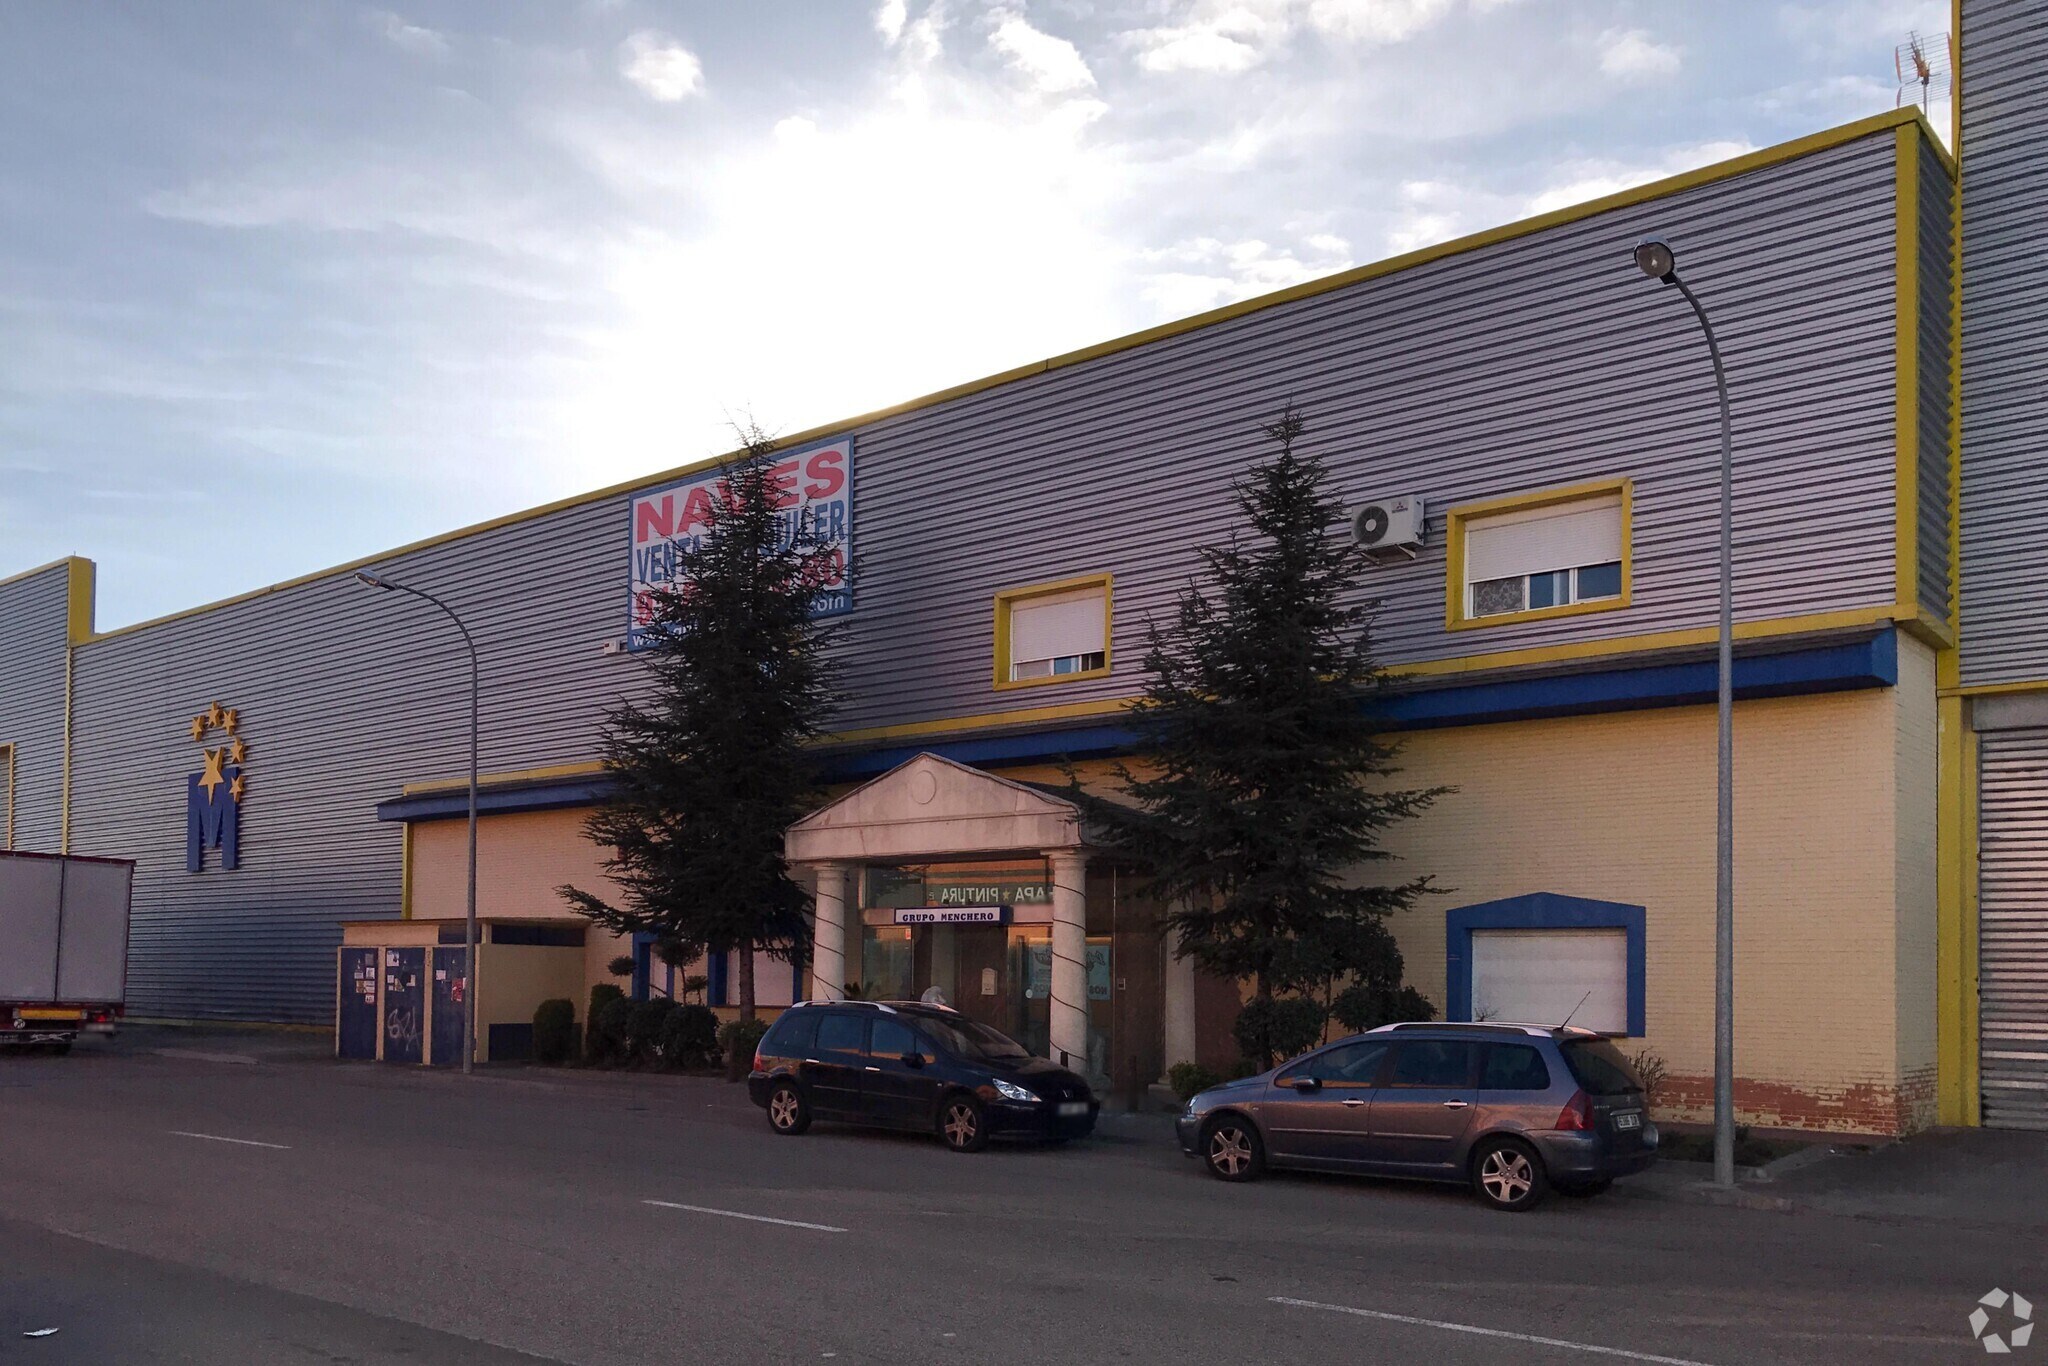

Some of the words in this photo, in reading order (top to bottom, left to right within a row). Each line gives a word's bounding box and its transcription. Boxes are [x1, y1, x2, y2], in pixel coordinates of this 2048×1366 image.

[637, 450, 845, 543] NAVES
[902, 913, 935, 922] GRUPO
[940, 912, 994, 921] MENCHERO
